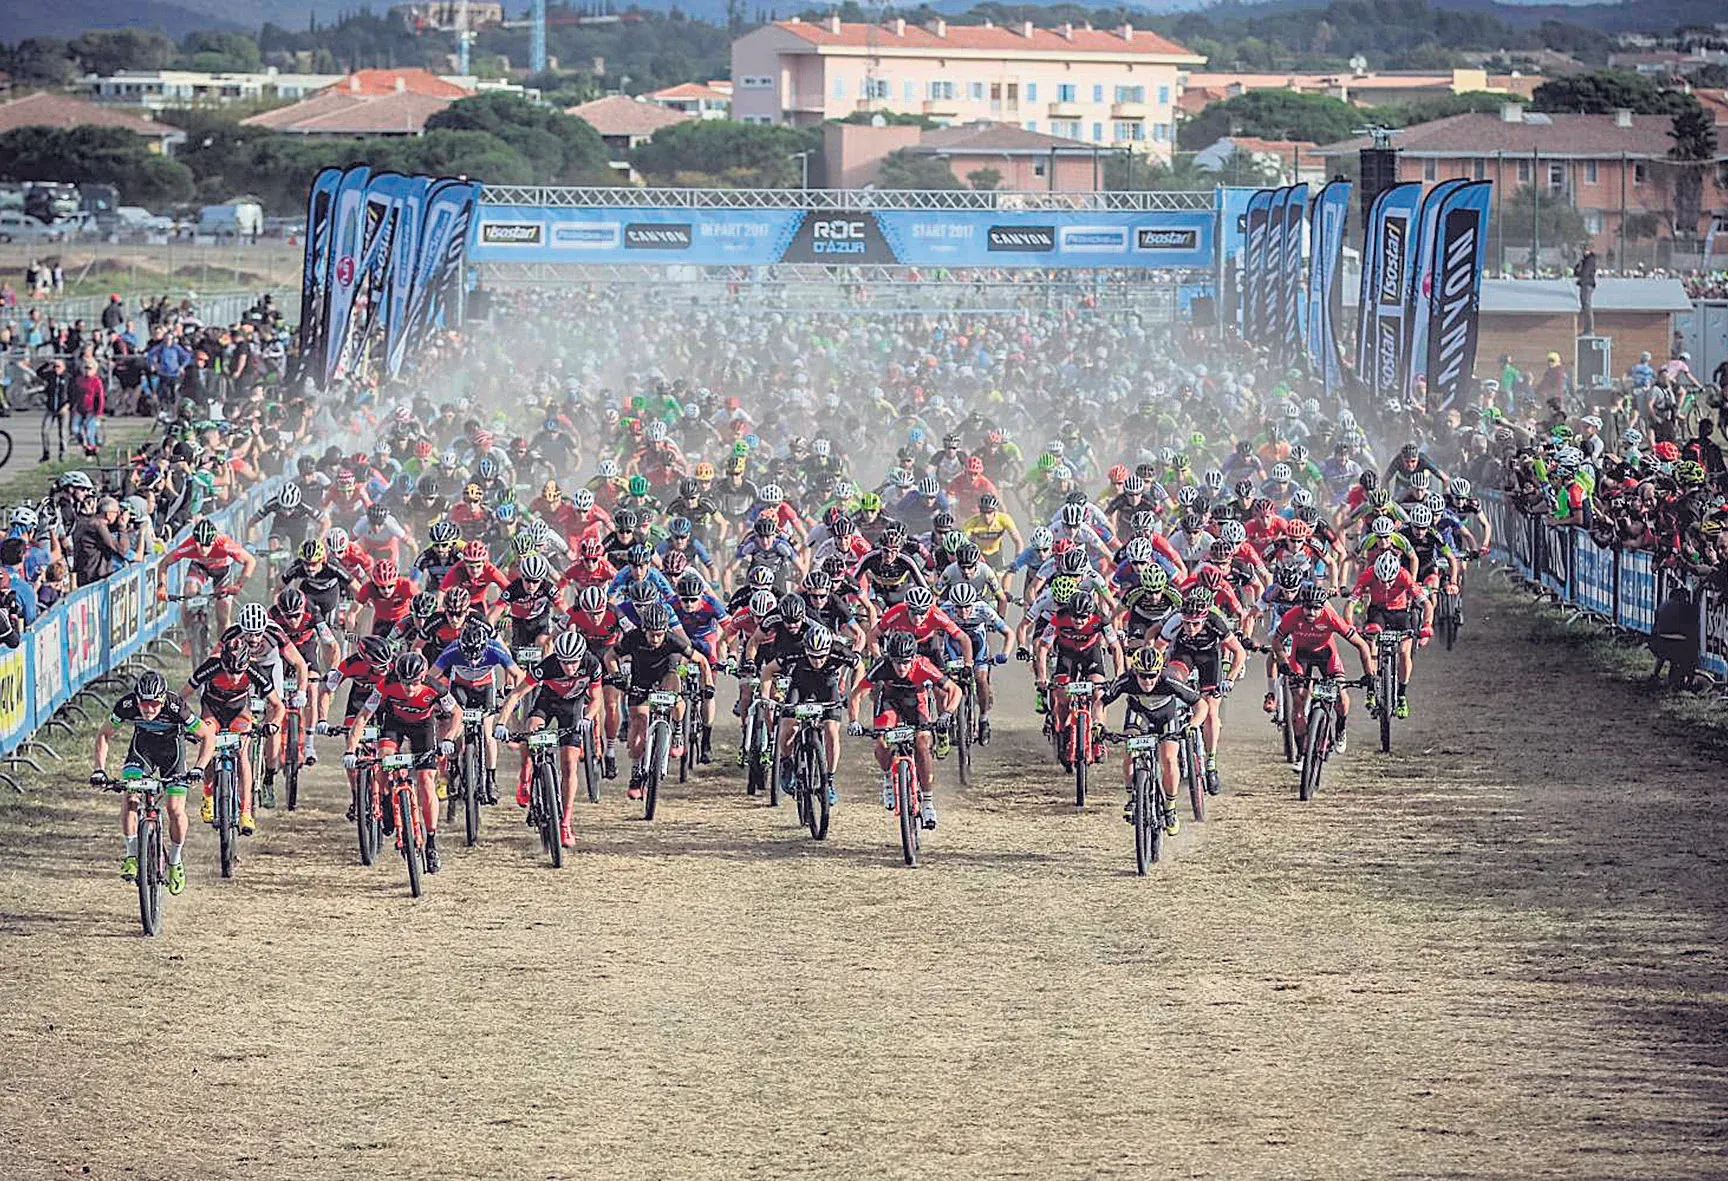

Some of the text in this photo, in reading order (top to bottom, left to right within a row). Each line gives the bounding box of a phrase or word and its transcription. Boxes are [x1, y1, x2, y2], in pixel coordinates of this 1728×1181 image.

[813, 220, 865, 239] ROC
[627, 230, 689, 243] CANYON
[991, 233, 1051, 245] CANYON
